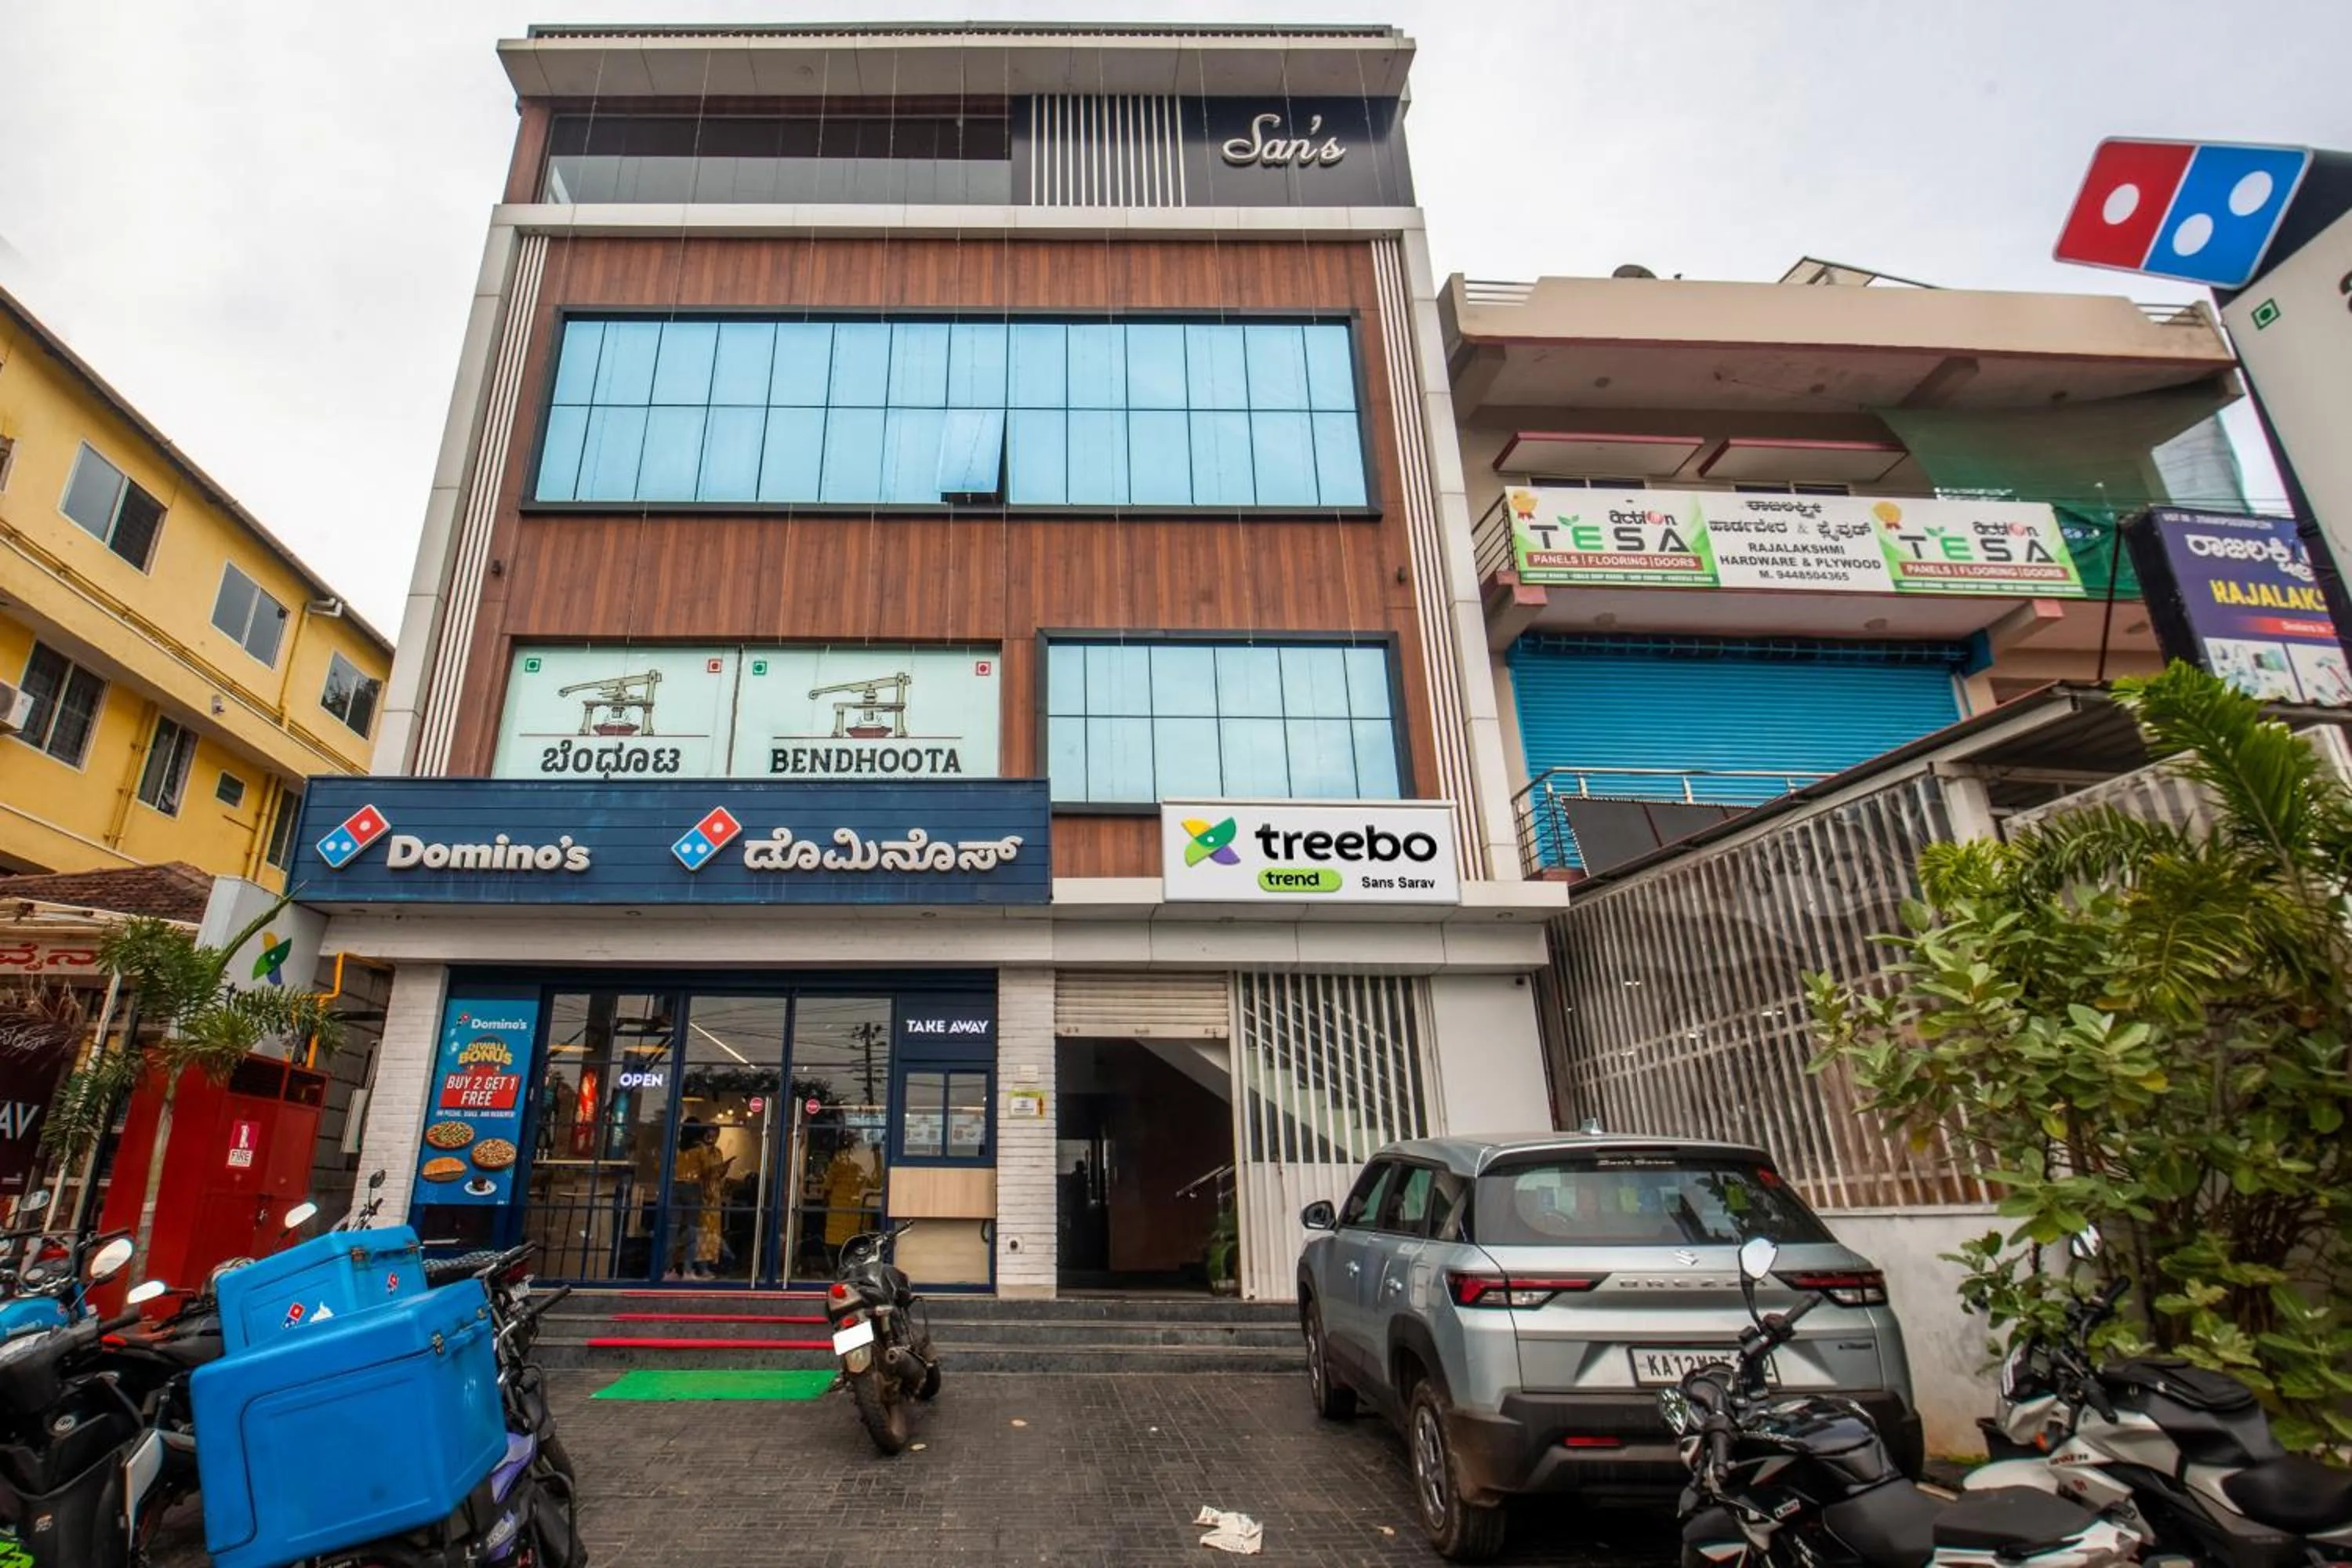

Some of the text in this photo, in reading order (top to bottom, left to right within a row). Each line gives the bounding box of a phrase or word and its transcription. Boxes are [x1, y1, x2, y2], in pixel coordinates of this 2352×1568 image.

[1221, 113, 1347, 165] San's
[1796, 523, 1809, 535] &
[1530, 524, 1690, 553] TESA
[1748, 542, 1846, 555] RAJALAKSHMI
[1898, 535, 2056, 564] TESA
[1533, 554, 1697, 568] PANELS FLOORING DOORS
[1719, 554, 1882, 569] HARDWARE & PLYWOOD
[769, 747, 963, 774] BENDHOOTA
[1254, 823, 1438, 863] treebo
[387, 833, 592, 873] Domino's
[1265, 871, 1320, 887] trend
[1361, 876, 1436, 889] Sans Sarav
[470, 1018, 528, 1030] Domino's
[906, 1020, 989, 1035] TAKE AWAY
[458, 1049, 514, 1065] BONUS
[446, 1075, 516, 1091] BUY 2 GET 1
[619, 1073, 664, 1088] OPEN
[460, 1091, 494, 1106] FREE
